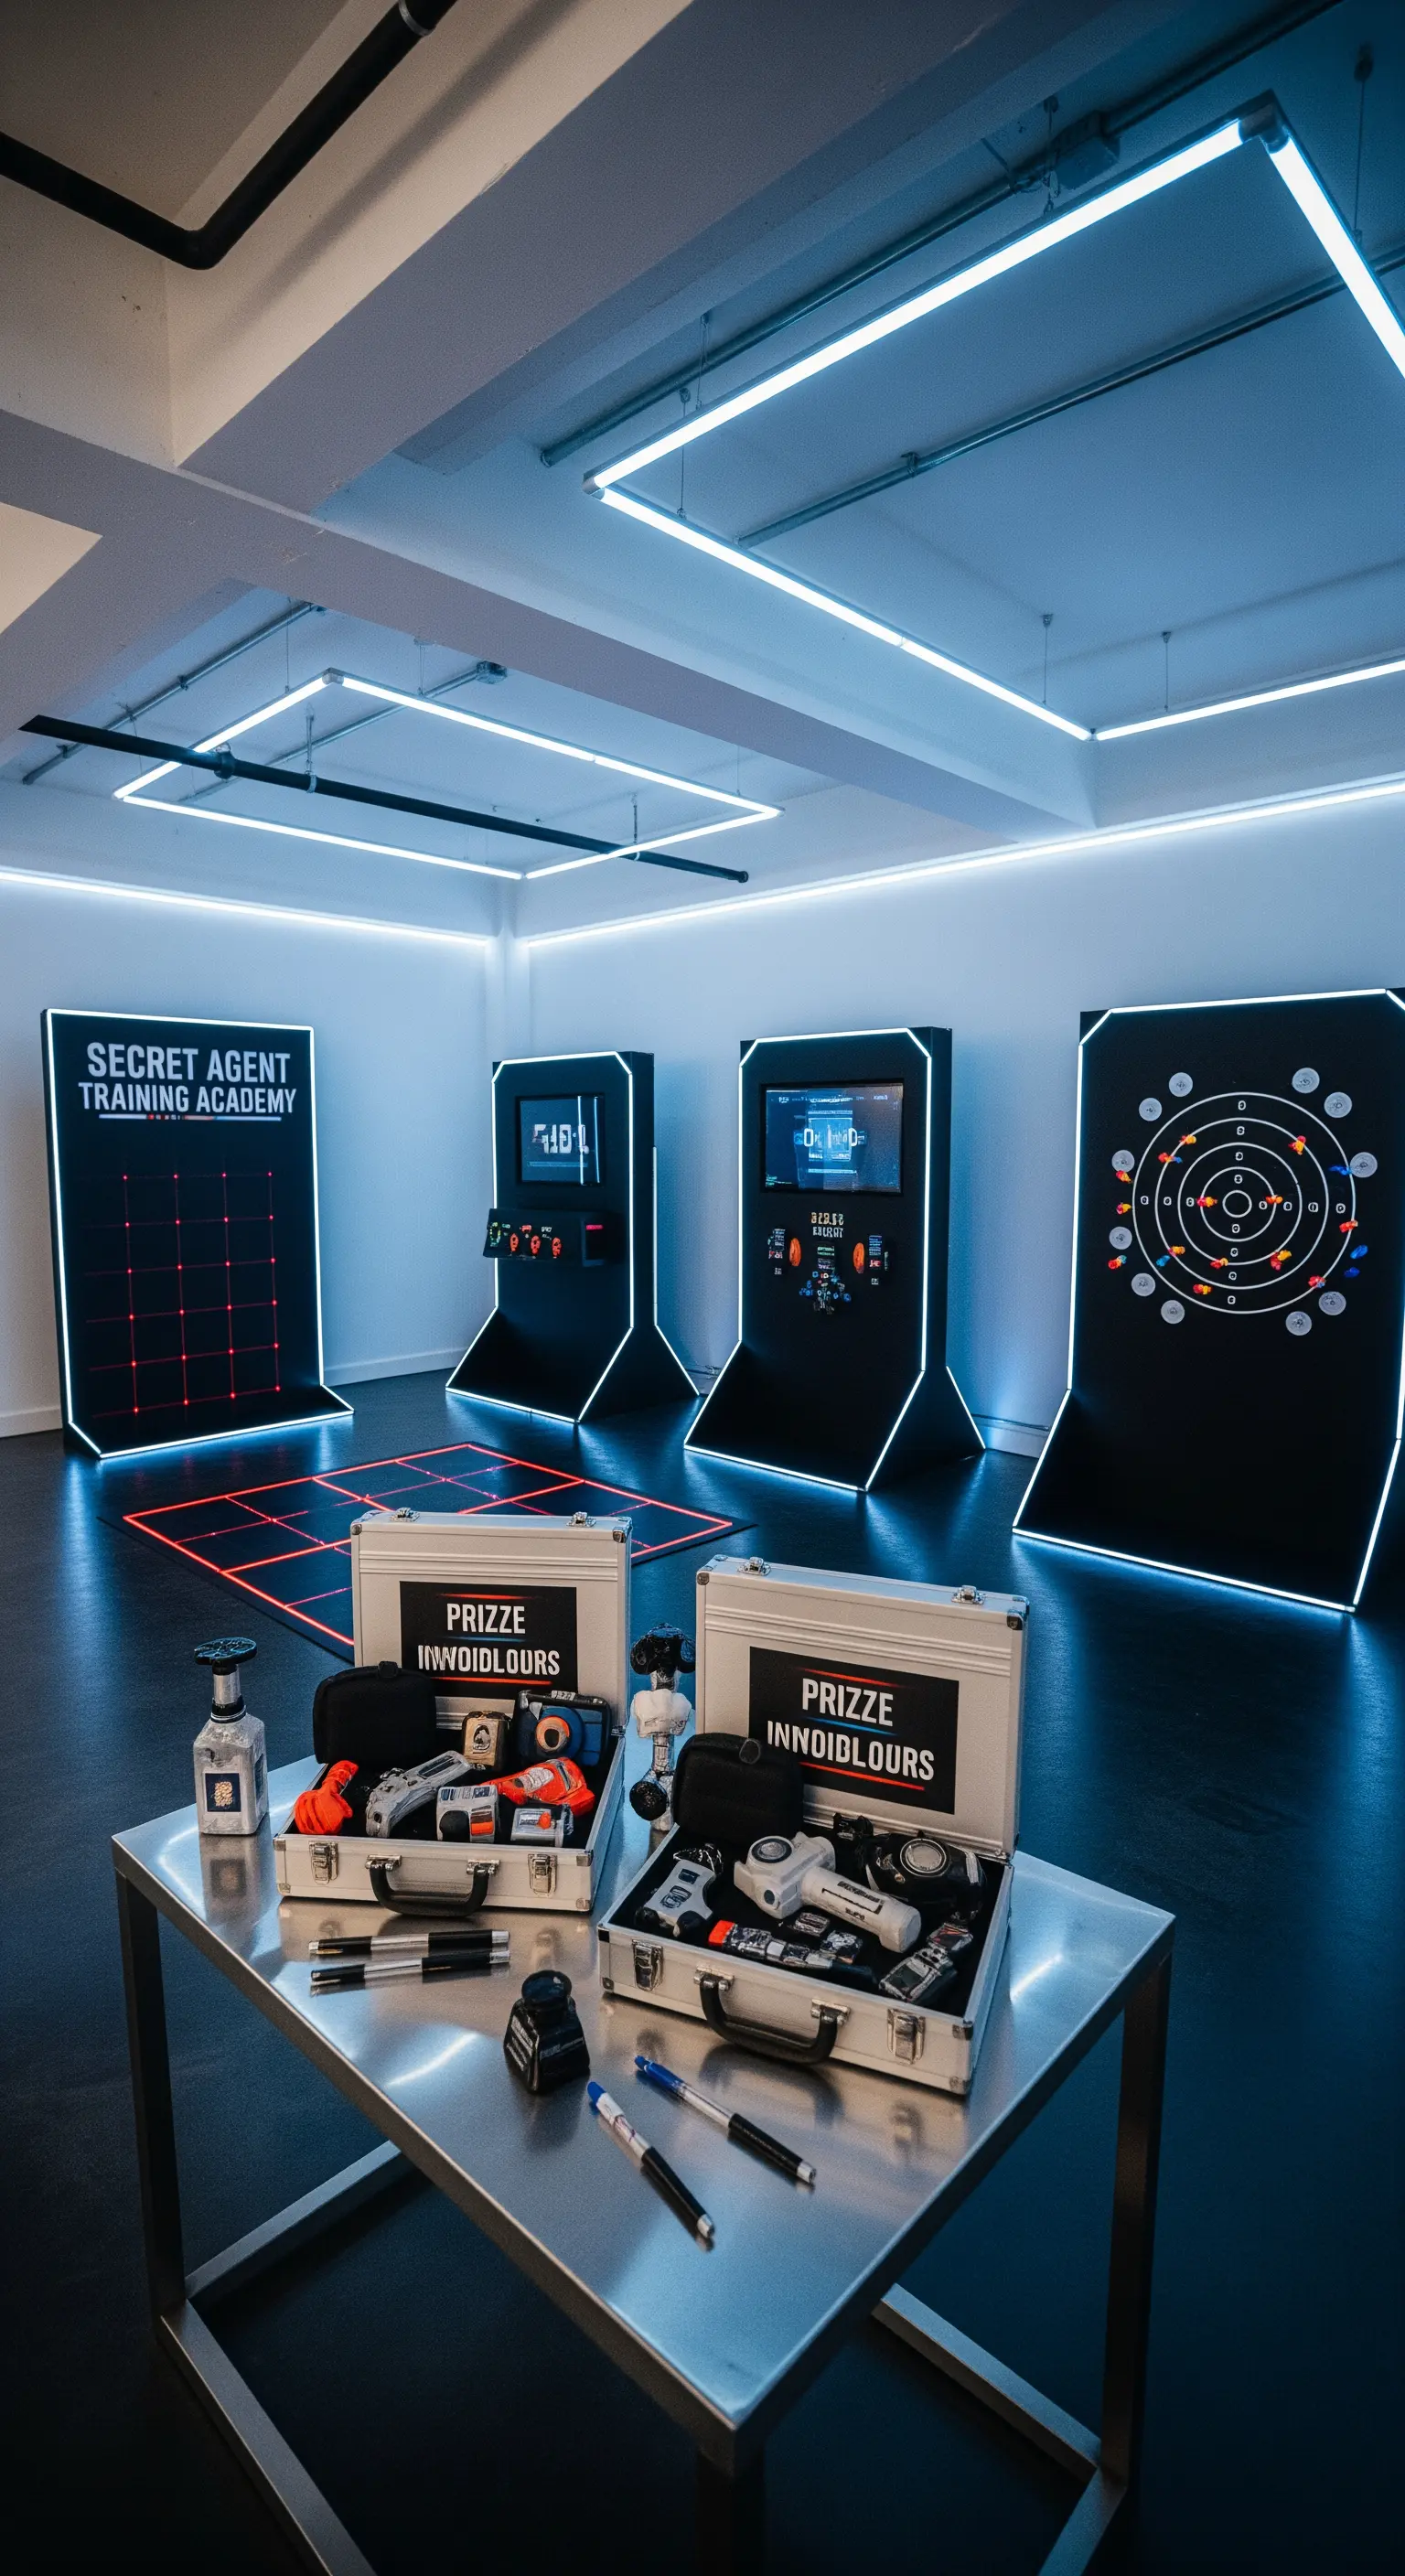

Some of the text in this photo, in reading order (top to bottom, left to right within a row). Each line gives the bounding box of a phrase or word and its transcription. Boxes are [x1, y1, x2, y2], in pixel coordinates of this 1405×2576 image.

[86, 1042, 291, 1084] SECRET AGENT
[78, 1081, 297, 1113] TRAINING ACADEMY
[446, 1603, 526, 1634] PRIZZE
[801, 1678, 894, 1727] PRIZZE
